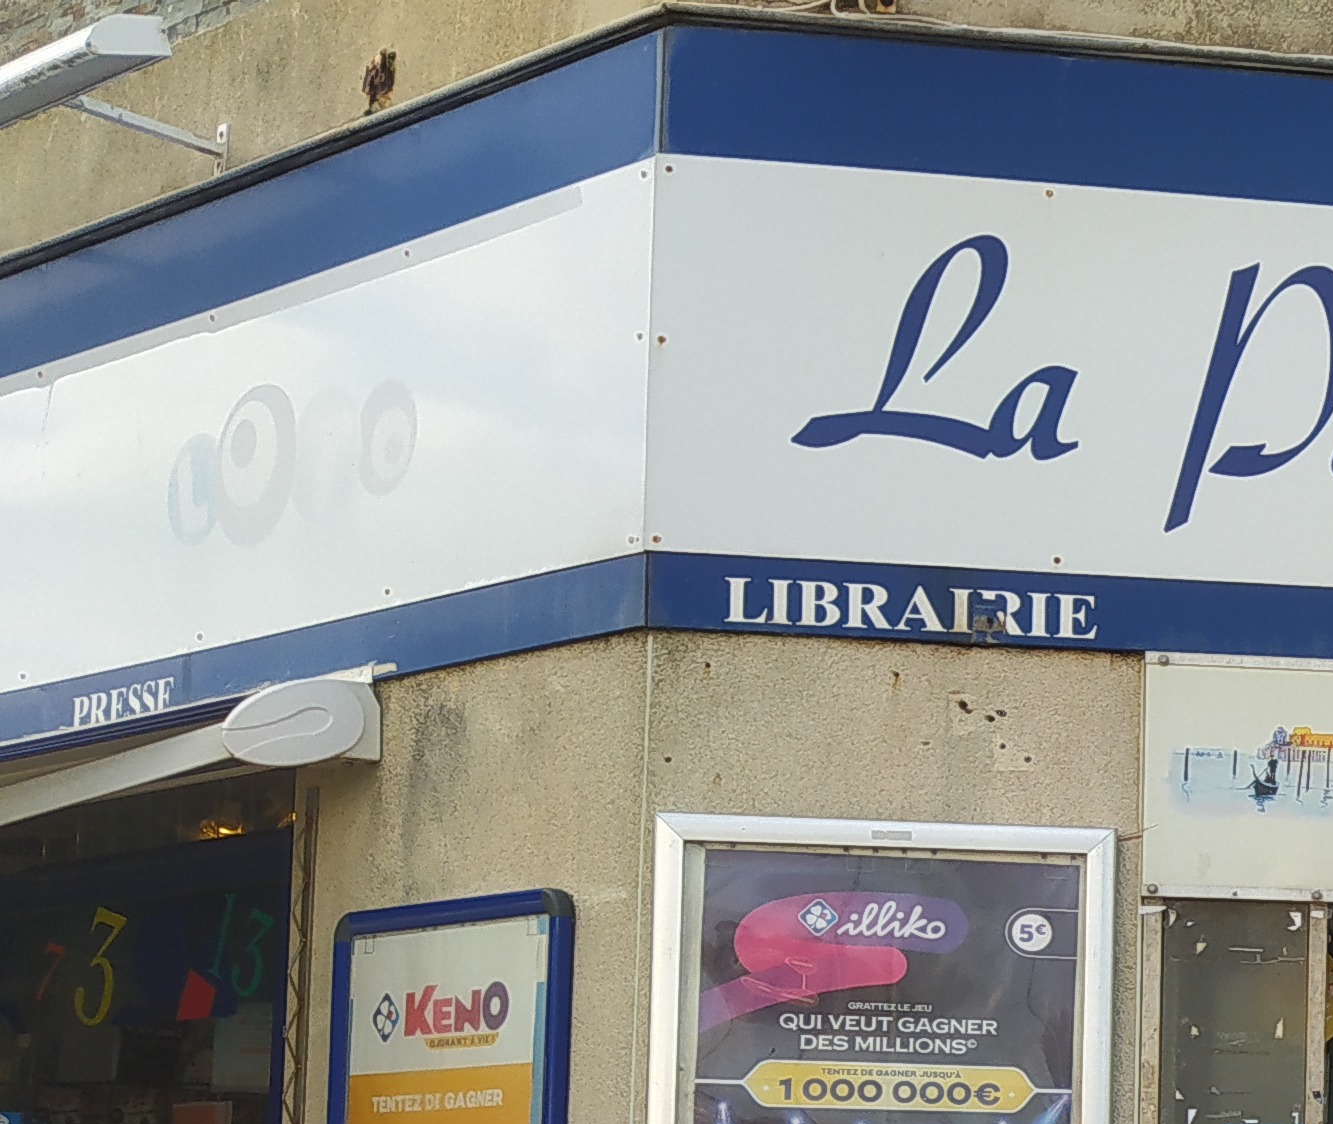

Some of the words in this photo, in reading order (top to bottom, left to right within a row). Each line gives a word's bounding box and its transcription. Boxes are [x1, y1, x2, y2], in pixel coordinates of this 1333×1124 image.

[791, 233, 1079, 461] La
[724, 576, 1097, 641] LIBRAIRIE
[72, 676, 174, 728] PRESSE
[837, 901, 946, 939] illiko
[404, 981, 509, 1037] KENO
[779, 1014, 823, 1031] QUI
[828, 1016, 893, 1032] VEUT
[898, 1017, 998, 1035] GAGNER
[848, 1002, 896, 1011] GRATTEZ
[800, 1035, 850, 1051] DES
